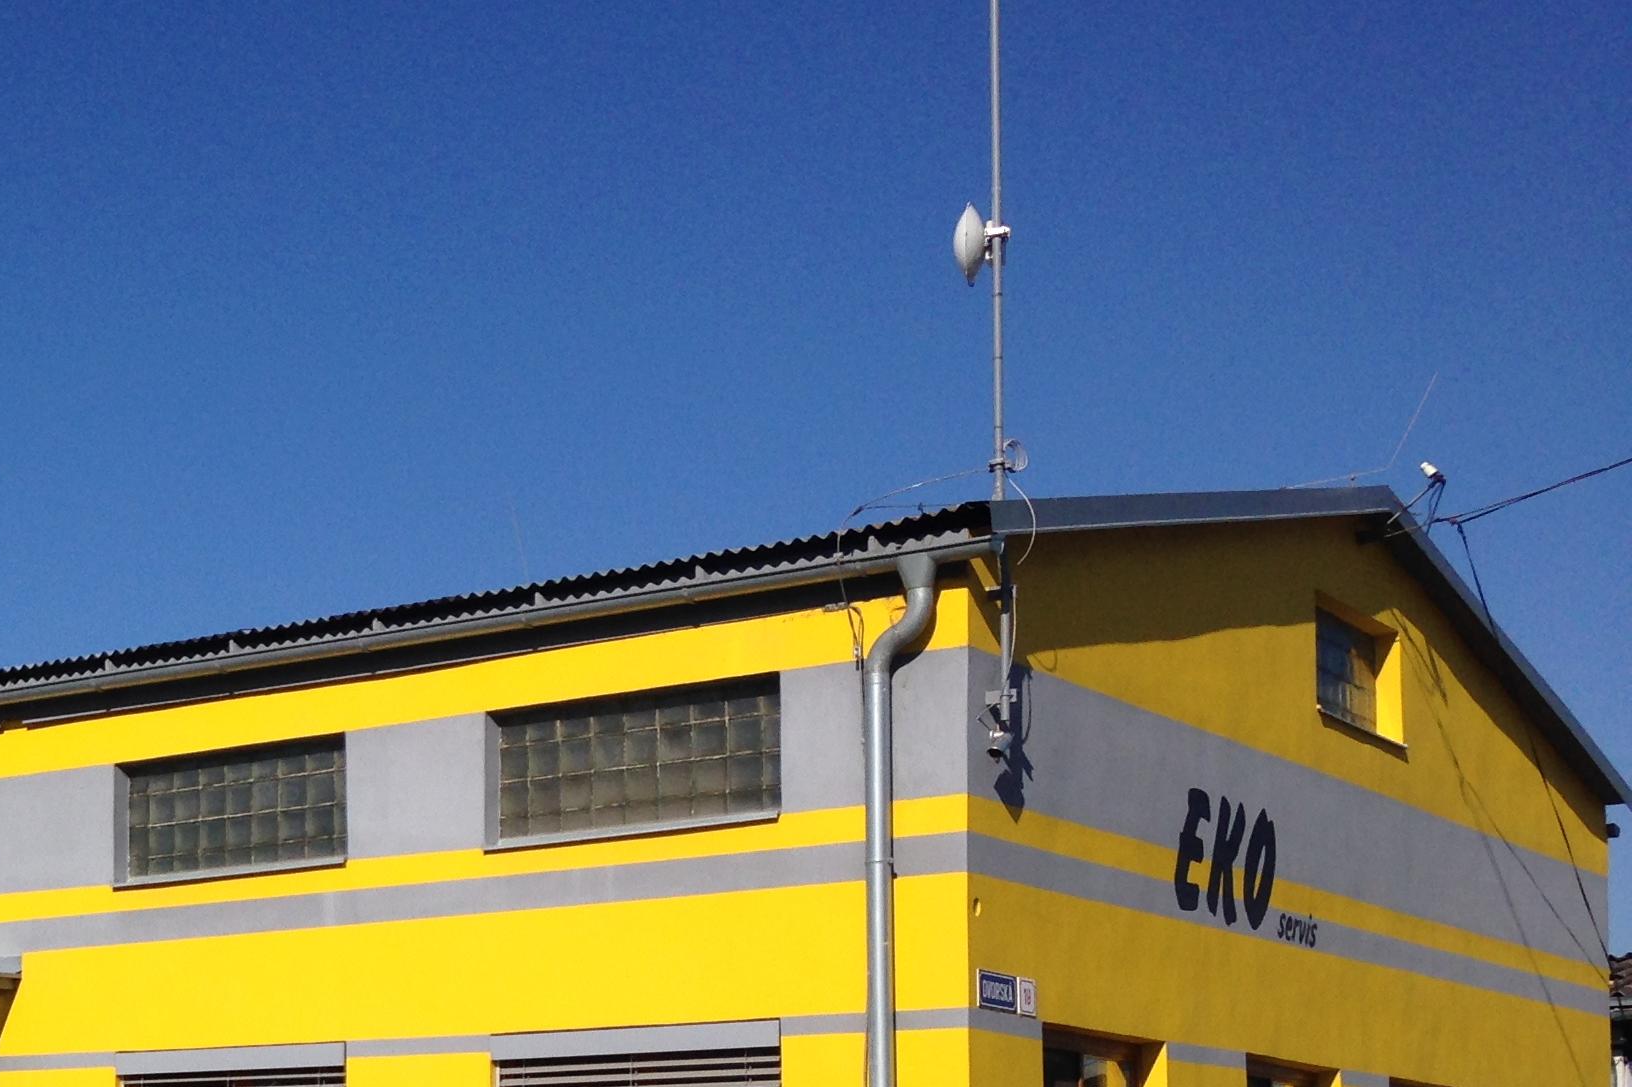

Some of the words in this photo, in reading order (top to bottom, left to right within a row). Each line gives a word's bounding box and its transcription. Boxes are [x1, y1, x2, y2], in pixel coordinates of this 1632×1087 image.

[1174, 788, 1276, 930] EKO
[1277, 912, 1318, 949] servis
[983, 979, 1013, 1002] DVORSKÁ
